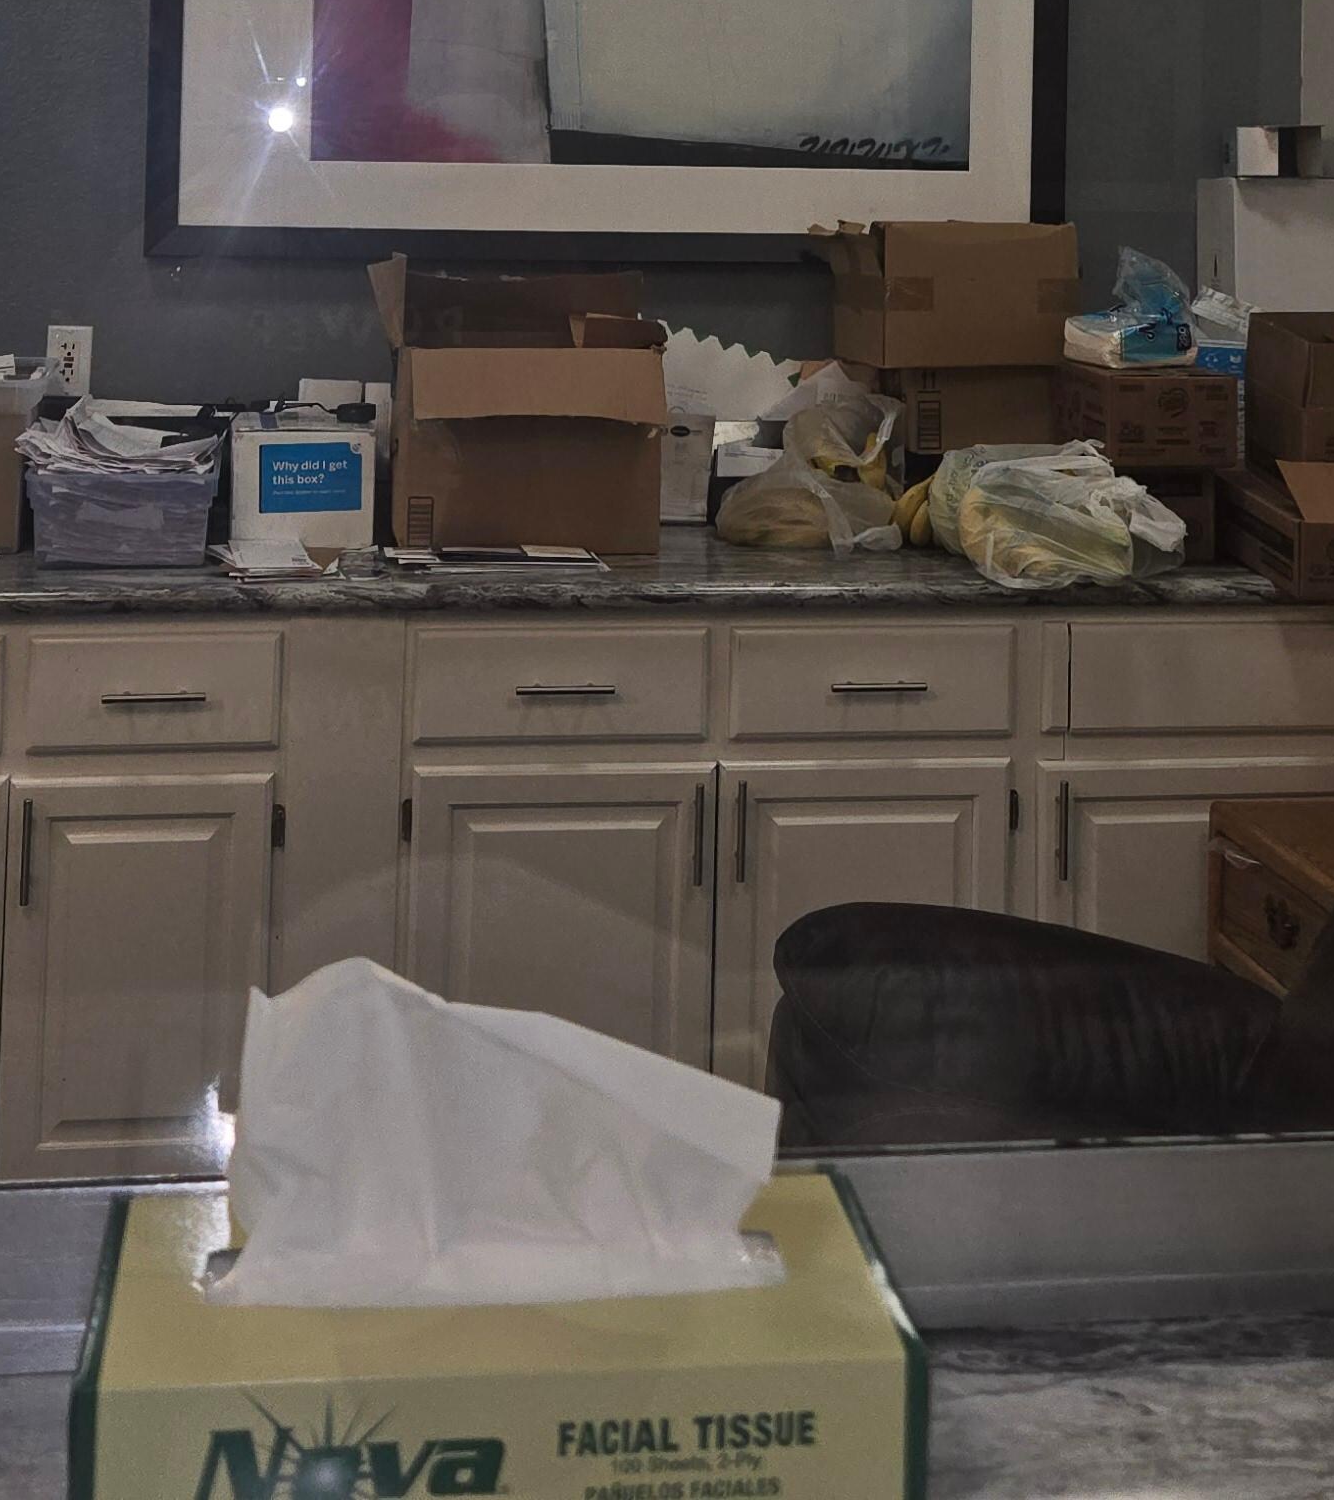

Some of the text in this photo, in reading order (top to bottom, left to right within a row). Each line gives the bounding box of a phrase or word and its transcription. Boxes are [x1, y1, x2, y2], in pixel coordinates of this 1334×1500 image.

[272, 460, 299, 473] Why
[301, 460, 320, 470] did
[328, 460, 348, 472] get
[272, 473, 325, 485] this box?
[557, 1410, 817, 1457] FACIAL TISSUE
[690, 1476, 780, 1497] FACIALES
